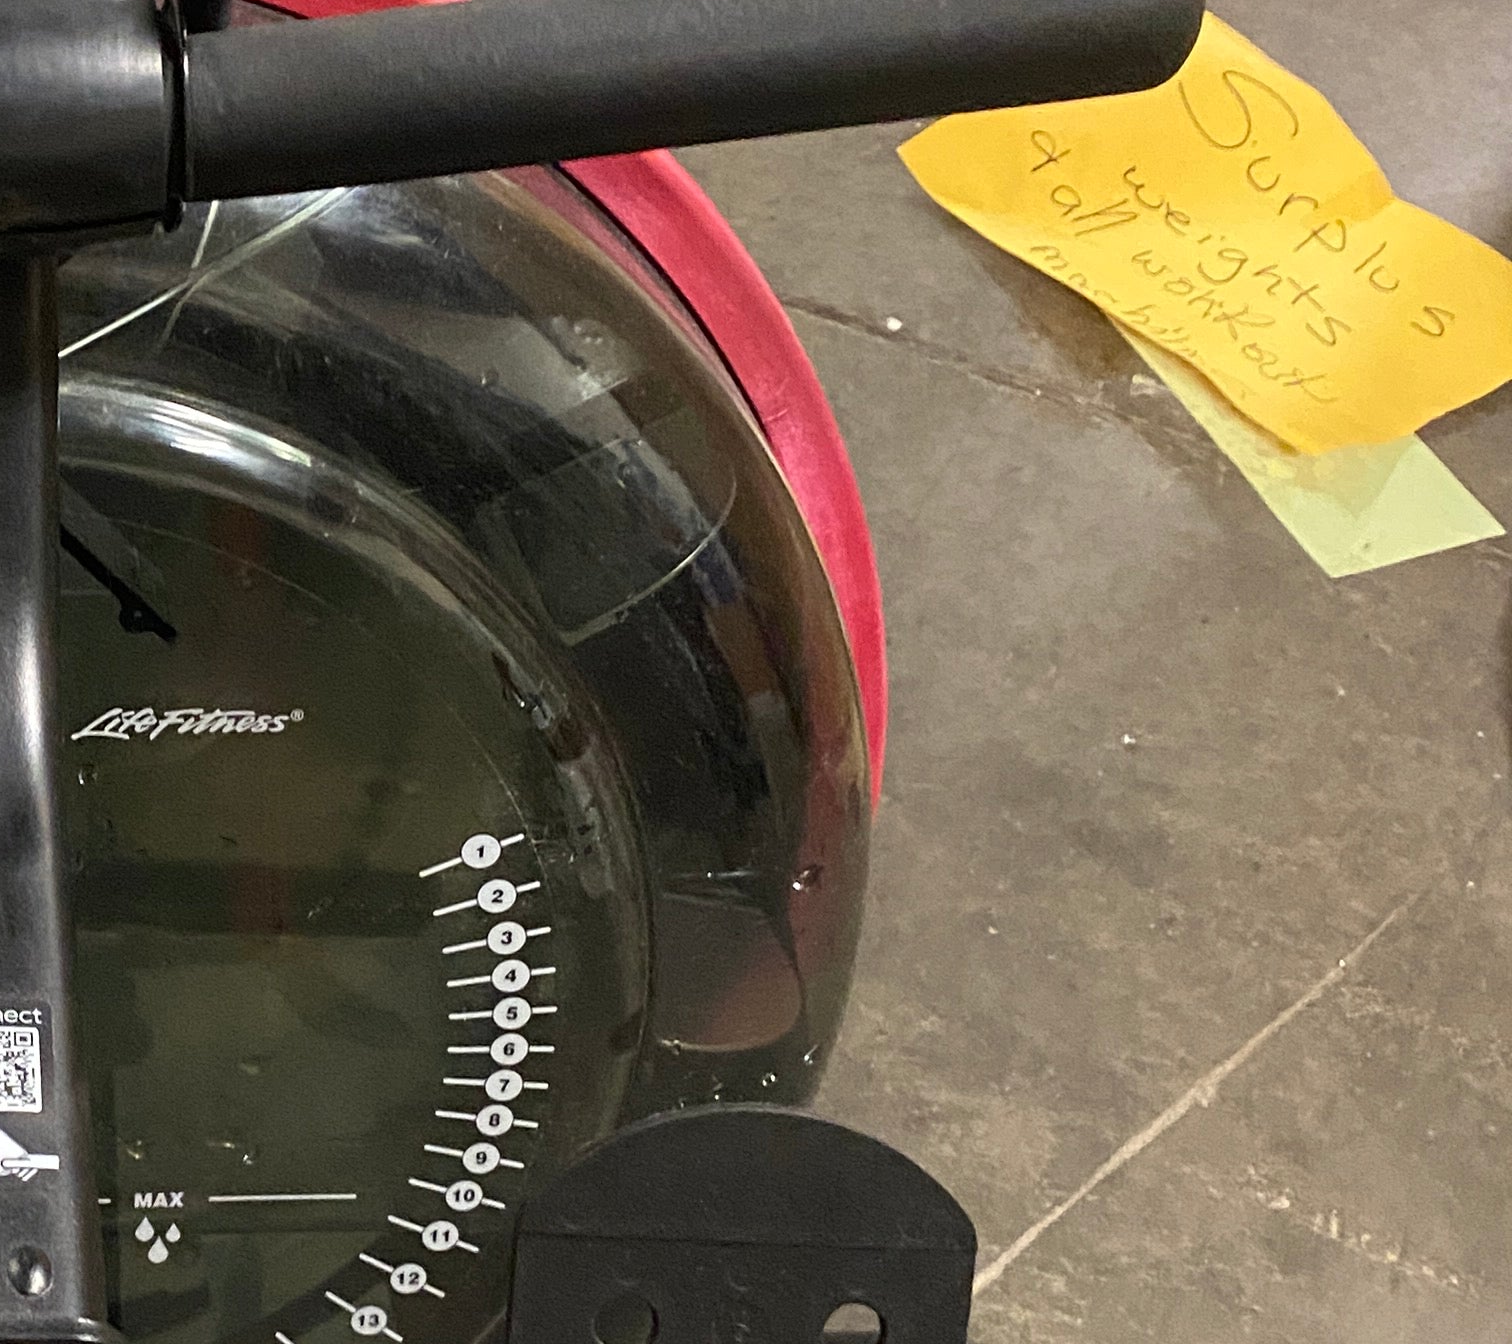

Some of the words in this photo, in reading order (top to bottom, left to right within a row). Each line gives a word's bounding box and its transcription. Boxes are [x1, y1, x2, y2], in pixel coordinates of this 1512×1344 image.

[1178, 68, 1456, 339] Surplus
[1122, 165, 1353, 348] weights
[476, 845, 485, 858] 1
[490, 888, 504, 904] 2
[500, 930, 513, 945] 3
[504, 968, 517, 983] 4
[506, 1006, 518, 1021] 5
[503, 1042, 515, 1056] 6
[499, 1078, 510, 1093] 7
[488, 1112, 500, 1127] 8
[475, 1151, 487, 1165] 9
[134, 1191, 185, 1209] MAX
[452, 1188, 475, 1203] 10
[430, 1229, 450, 1244] 11
[397, 1272, 420, 1285] 12
[358, 1313, 379, 1327] 13
